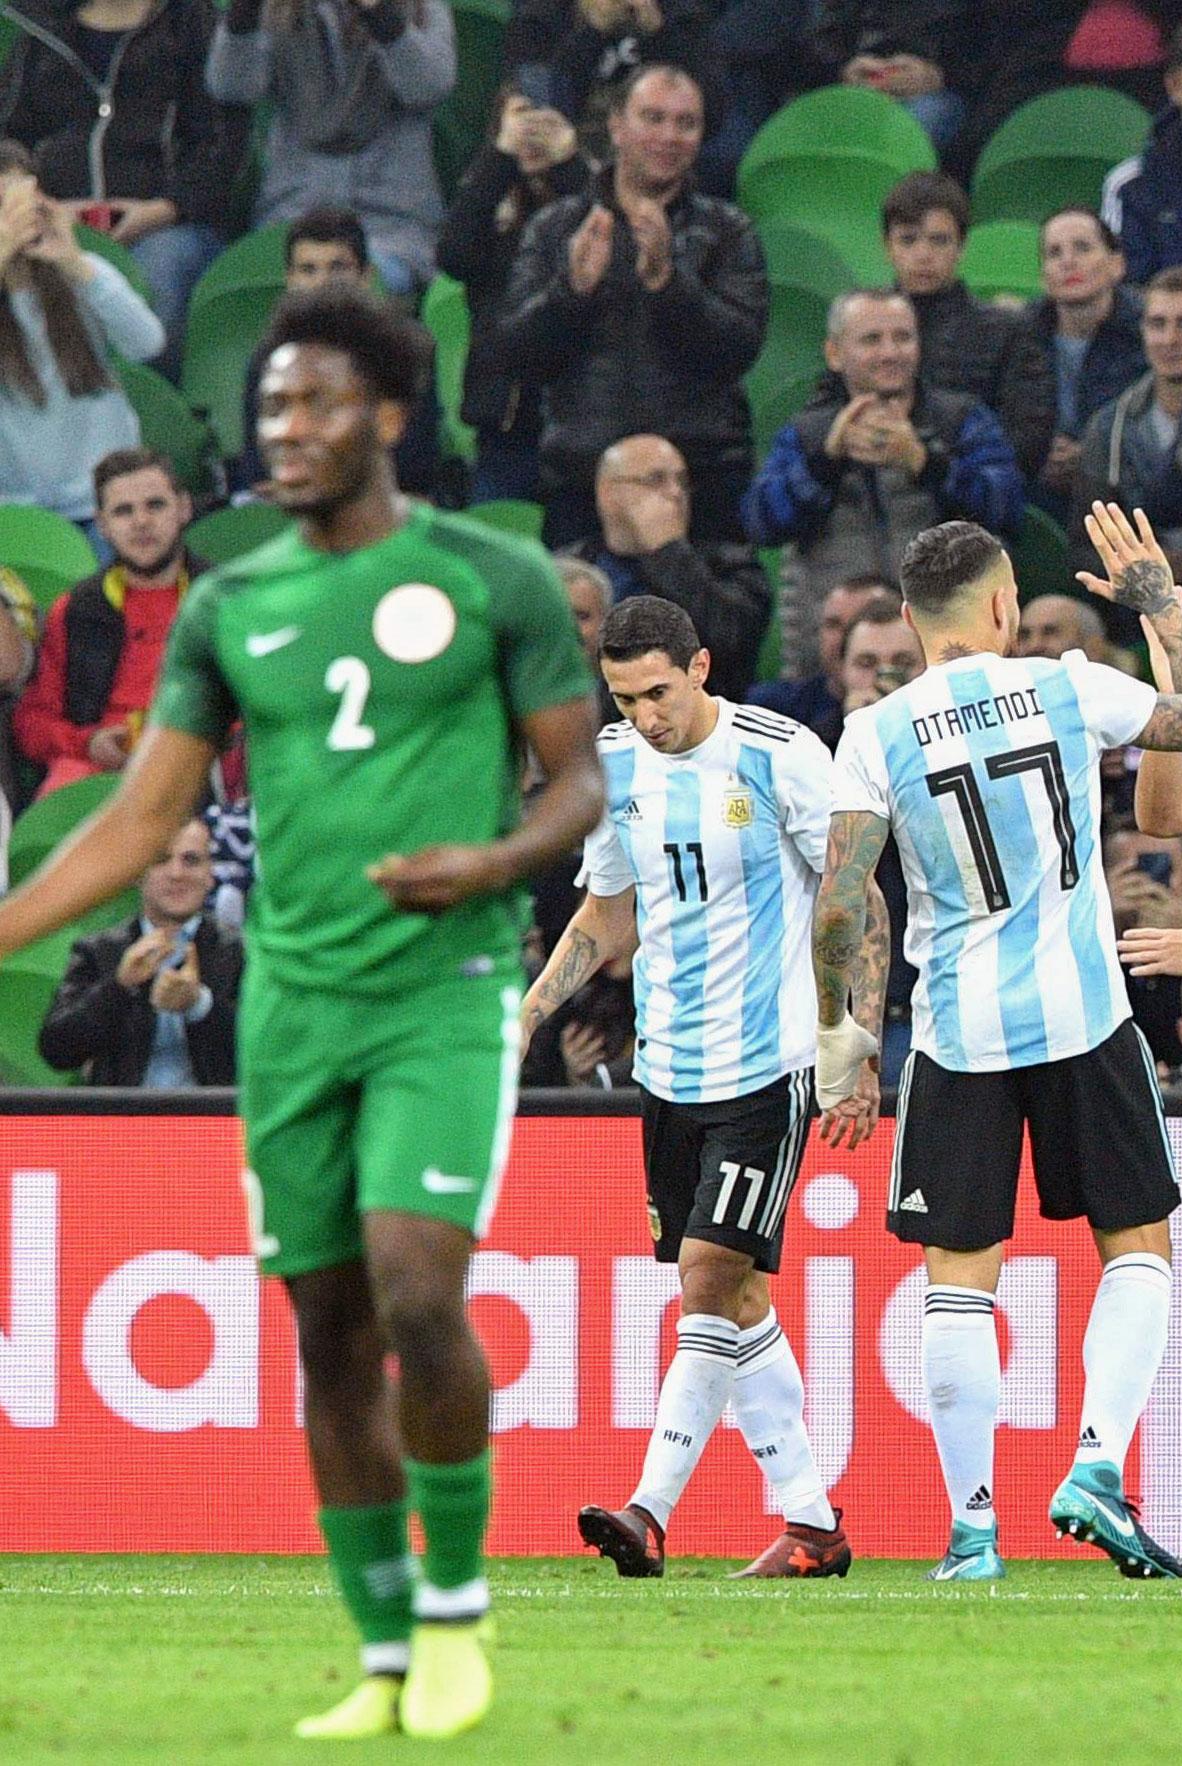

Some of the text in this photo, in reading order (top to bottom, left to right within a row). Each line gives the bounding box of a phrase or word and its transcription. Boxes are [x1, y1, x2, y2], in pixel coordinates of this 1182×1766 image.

[324, 656, 376, 752] 2
[912, 688, 1045, 747] OTAMENDI
[926, 740, 1081, 915] 17
[663, 843, 709, 902] 11
[712, 1160, 766, 1231] 11
[663, 1430, 693, 1449] AFA
